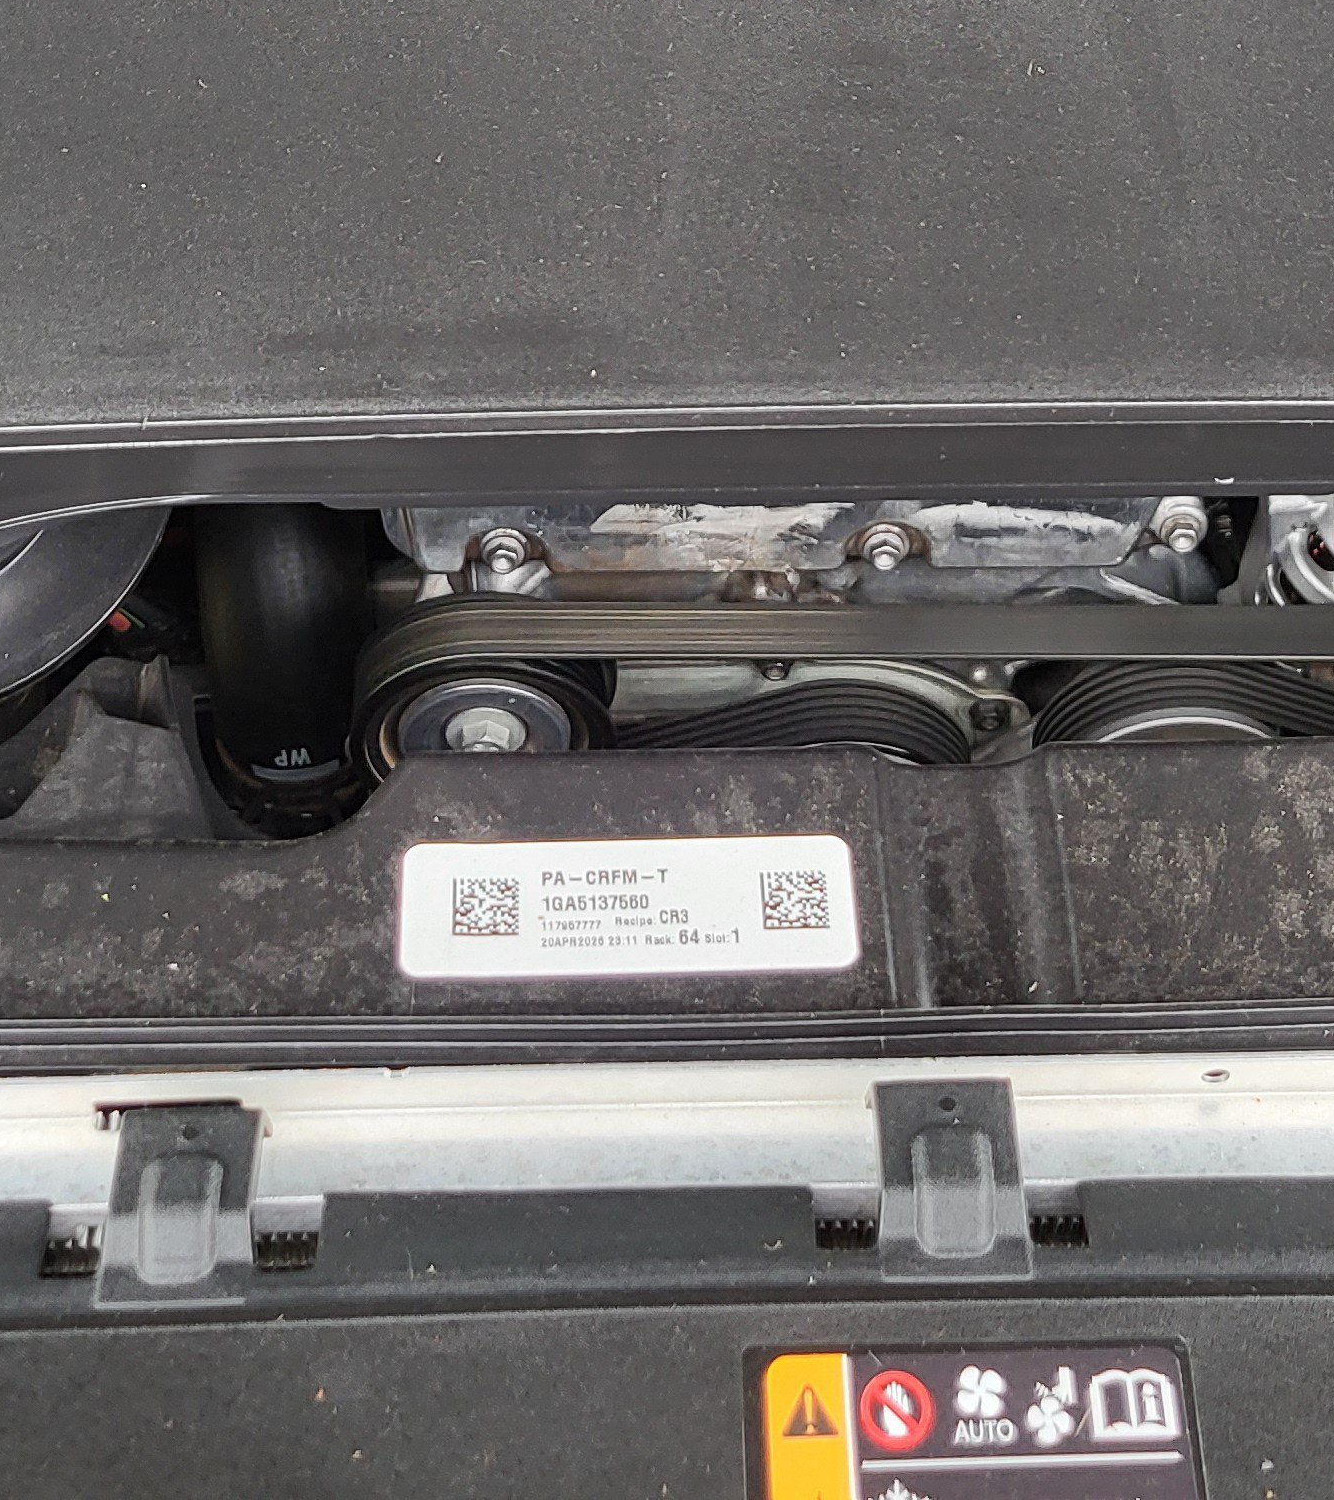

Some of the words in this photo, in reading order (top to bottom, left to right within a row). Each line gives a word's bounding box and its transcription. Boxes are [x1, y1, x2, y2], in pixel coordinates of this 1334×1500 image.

[274, 747, 312, 767] WP
[614, 914, 657, 929] Recipe:
[659, 908, 690, 925] CR3
[644, 933, 675, 946] Rack:
[678, 927, 701, 945] 64
[704, 932, 731, 944] Slot:
[731, 926, 741, 944] 1
[953, 1417, 1017, 1444] AUTO
